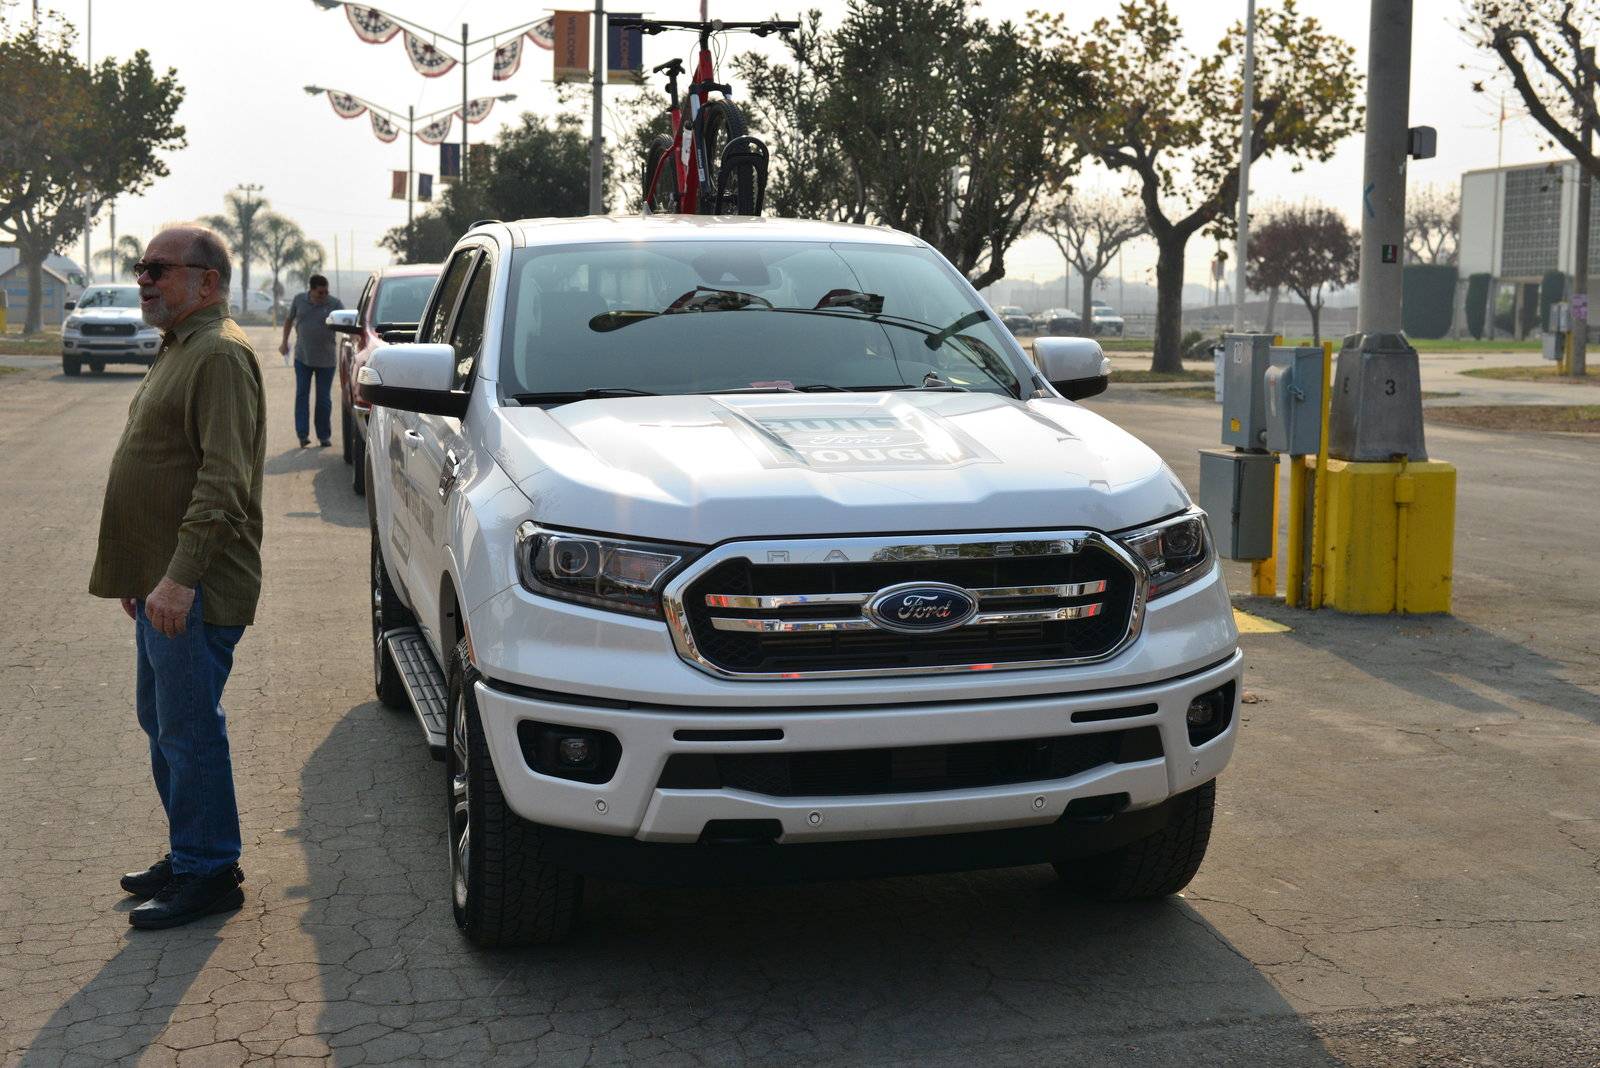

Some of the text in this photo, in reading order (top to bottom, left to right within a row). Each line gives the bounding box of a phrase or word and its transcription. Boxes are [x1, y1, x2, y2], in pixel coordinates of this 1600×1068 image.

[567, 15, 576, 67] WELCOME
[1385, 379, 1396, 396] 3
[897, 595, 953, 620] Ford
